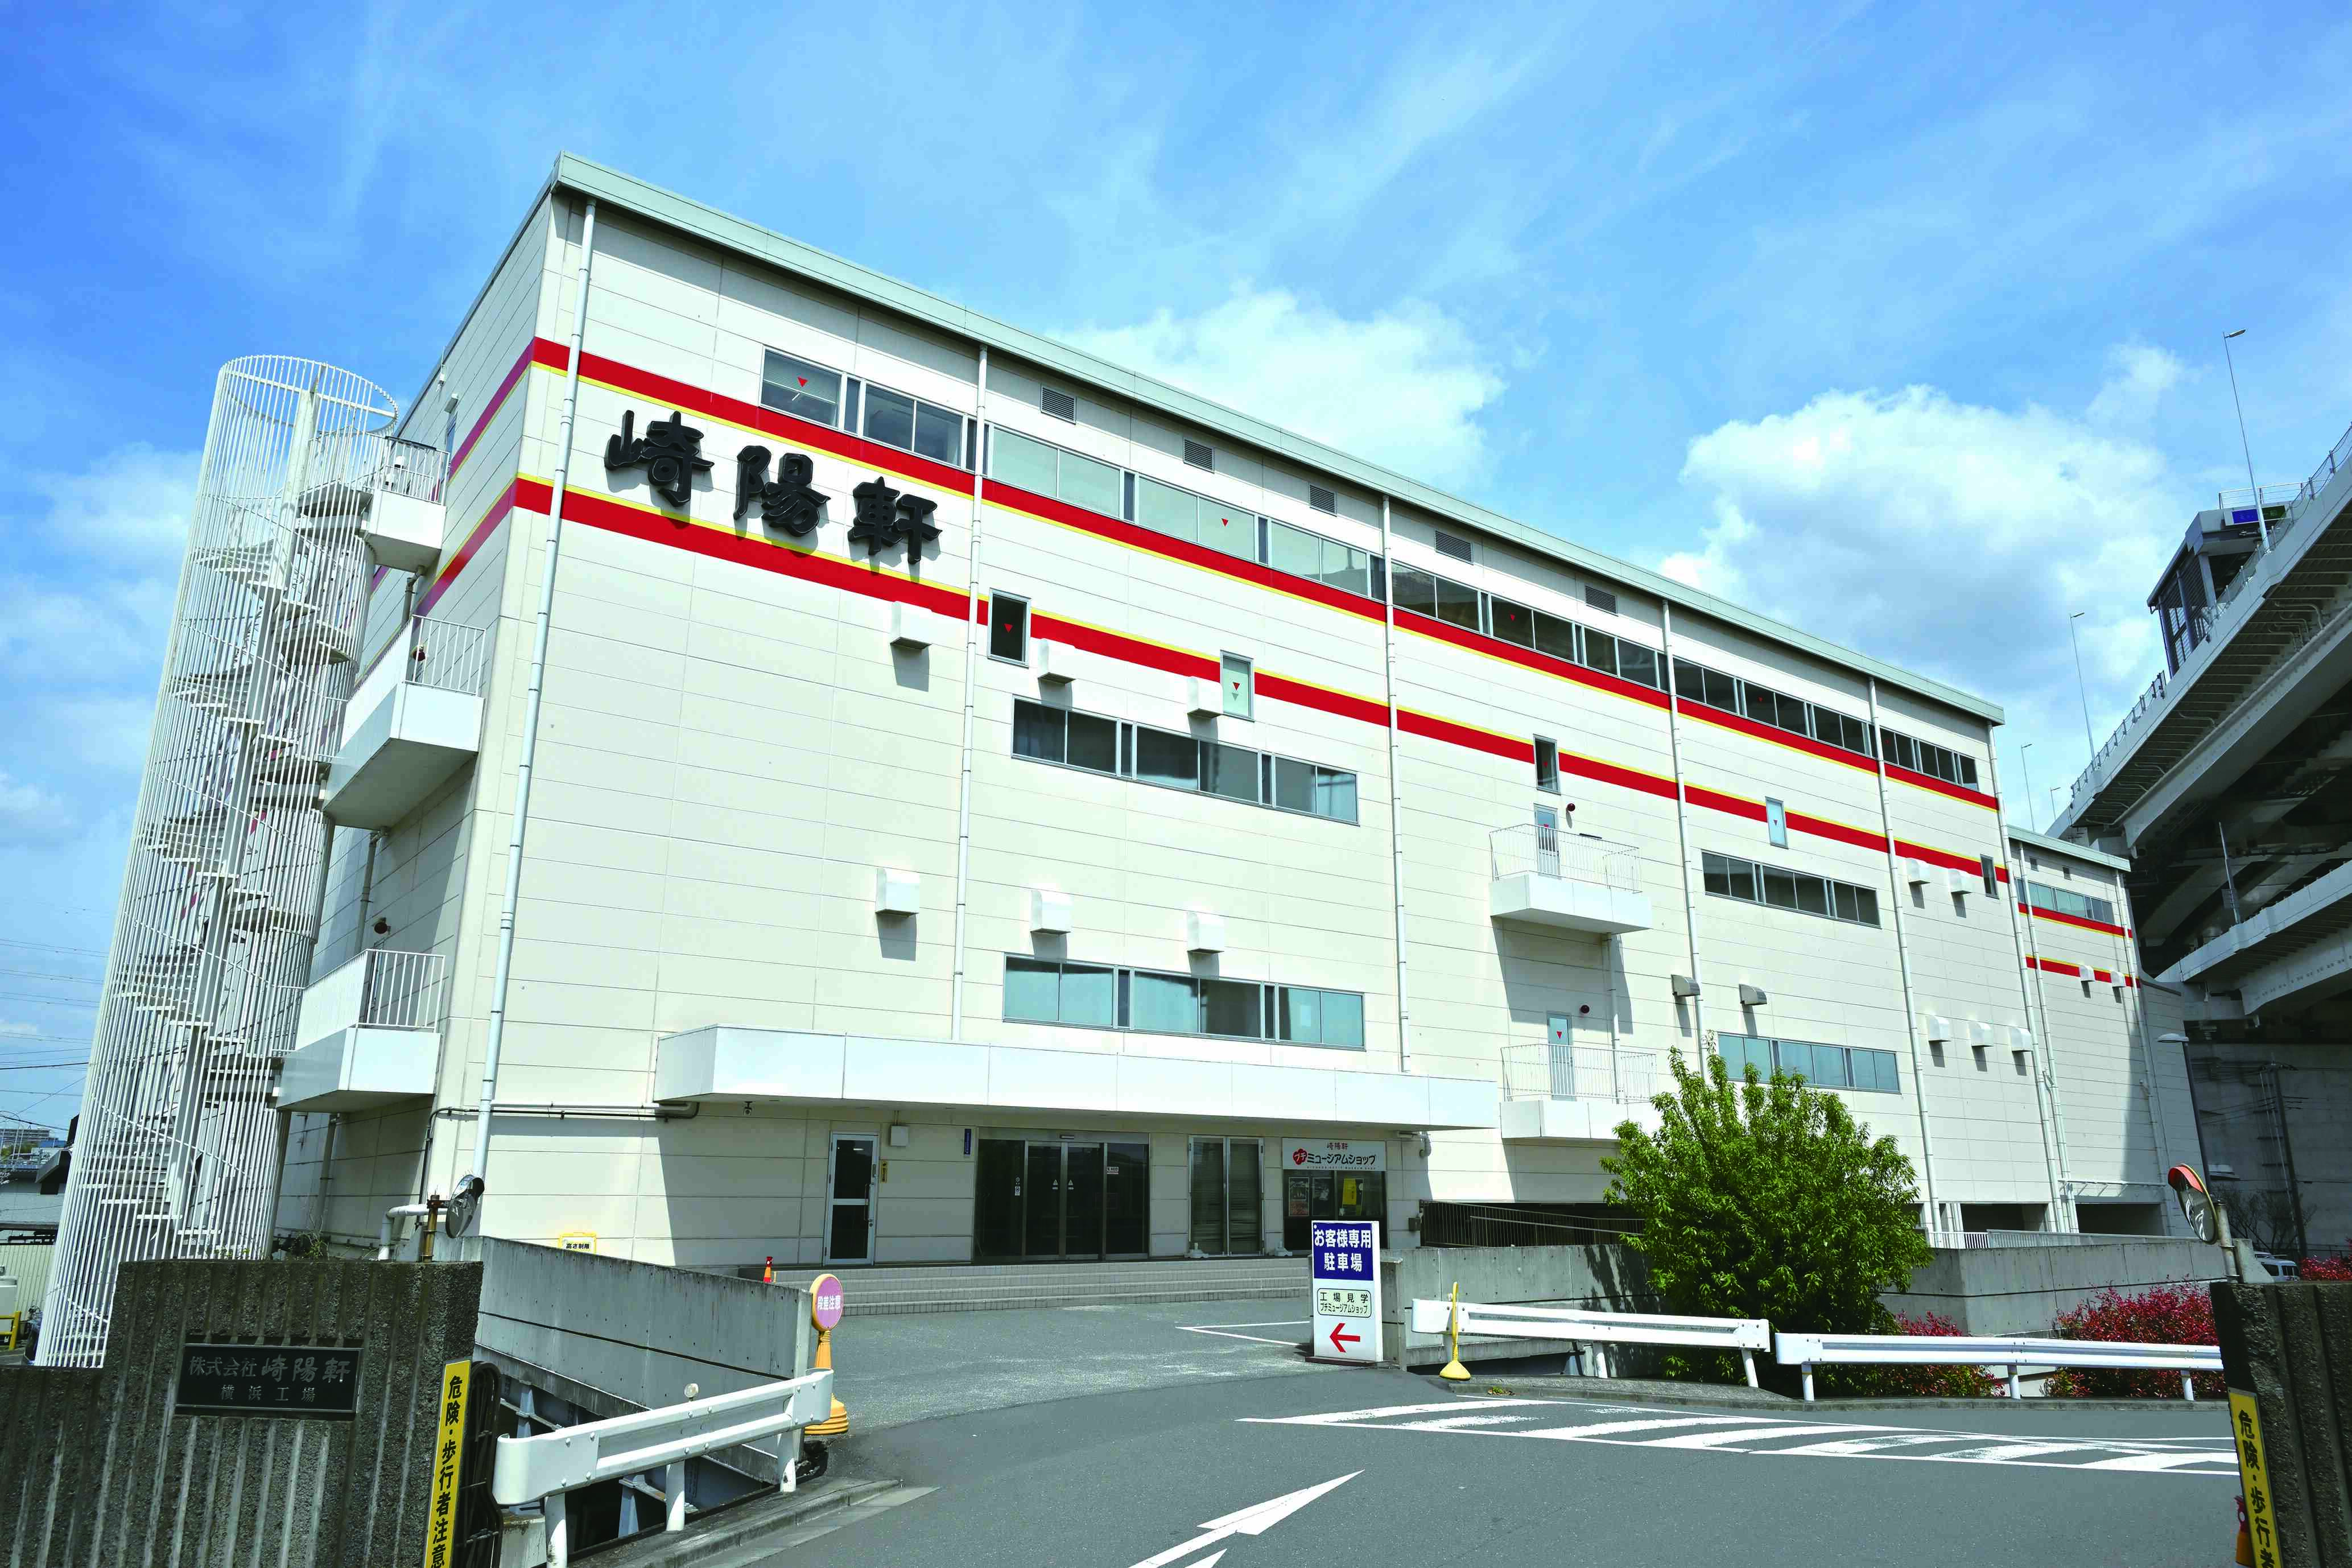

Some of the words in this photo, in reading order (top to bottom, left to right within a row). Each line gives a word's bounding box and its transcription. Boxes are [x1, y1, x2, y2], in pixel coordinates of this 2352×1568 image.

[604, 410, 943, 564] 崎陽軒
[1314, 1229, 1372, 1248] お客様専用
[1324, 1253, 1363, 1272] 駐車場
[818, 1295, 840, 1310] 段差注意
[1320, 1292, 1368, 1303] 工場見学
[1320, 1302, 1368, 1314] プチミュージアムショップ
[221, 1384, 316, 1402] 横浜工場
[431, 1376, 463, 1568] 危険・歩行者注意
